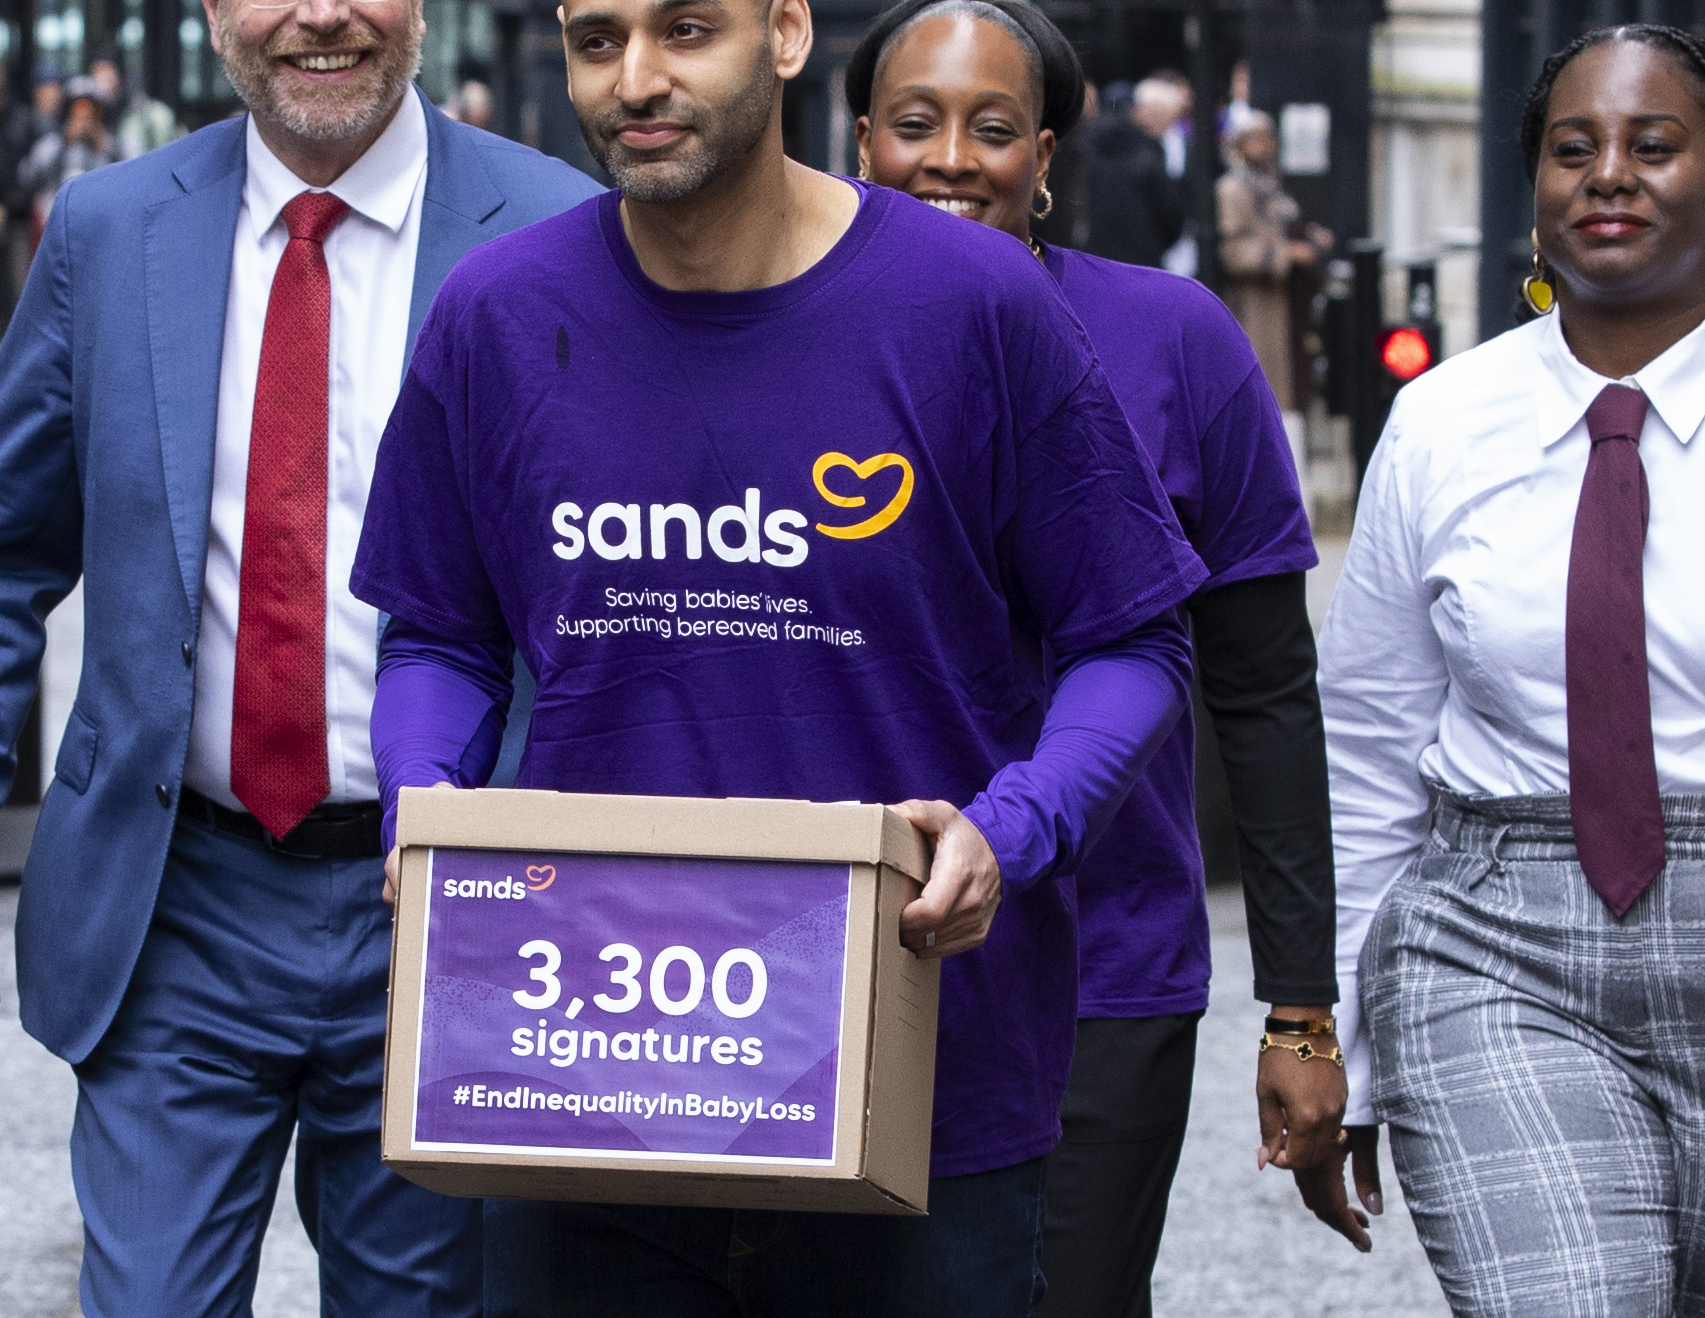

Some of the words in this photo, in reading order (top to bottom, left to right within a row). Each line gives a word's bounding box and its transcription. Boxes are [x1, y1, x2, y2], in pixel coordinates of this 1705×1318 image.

[551, 487, 809, 568] sands
[604, 587, 678, 613] Saving
[555, 614, 672, 639] Supporting
[677, 616, 778, 641] bereaved
[783, 619, 866, 646] families.
[443, 874, 527, 901] sands
[511, 938, 769, 1020] 3,300
[509, 1018, 765, 1068] signatures
[452, 1084, 817, 1124] #EndInequalityInBabyLoss
